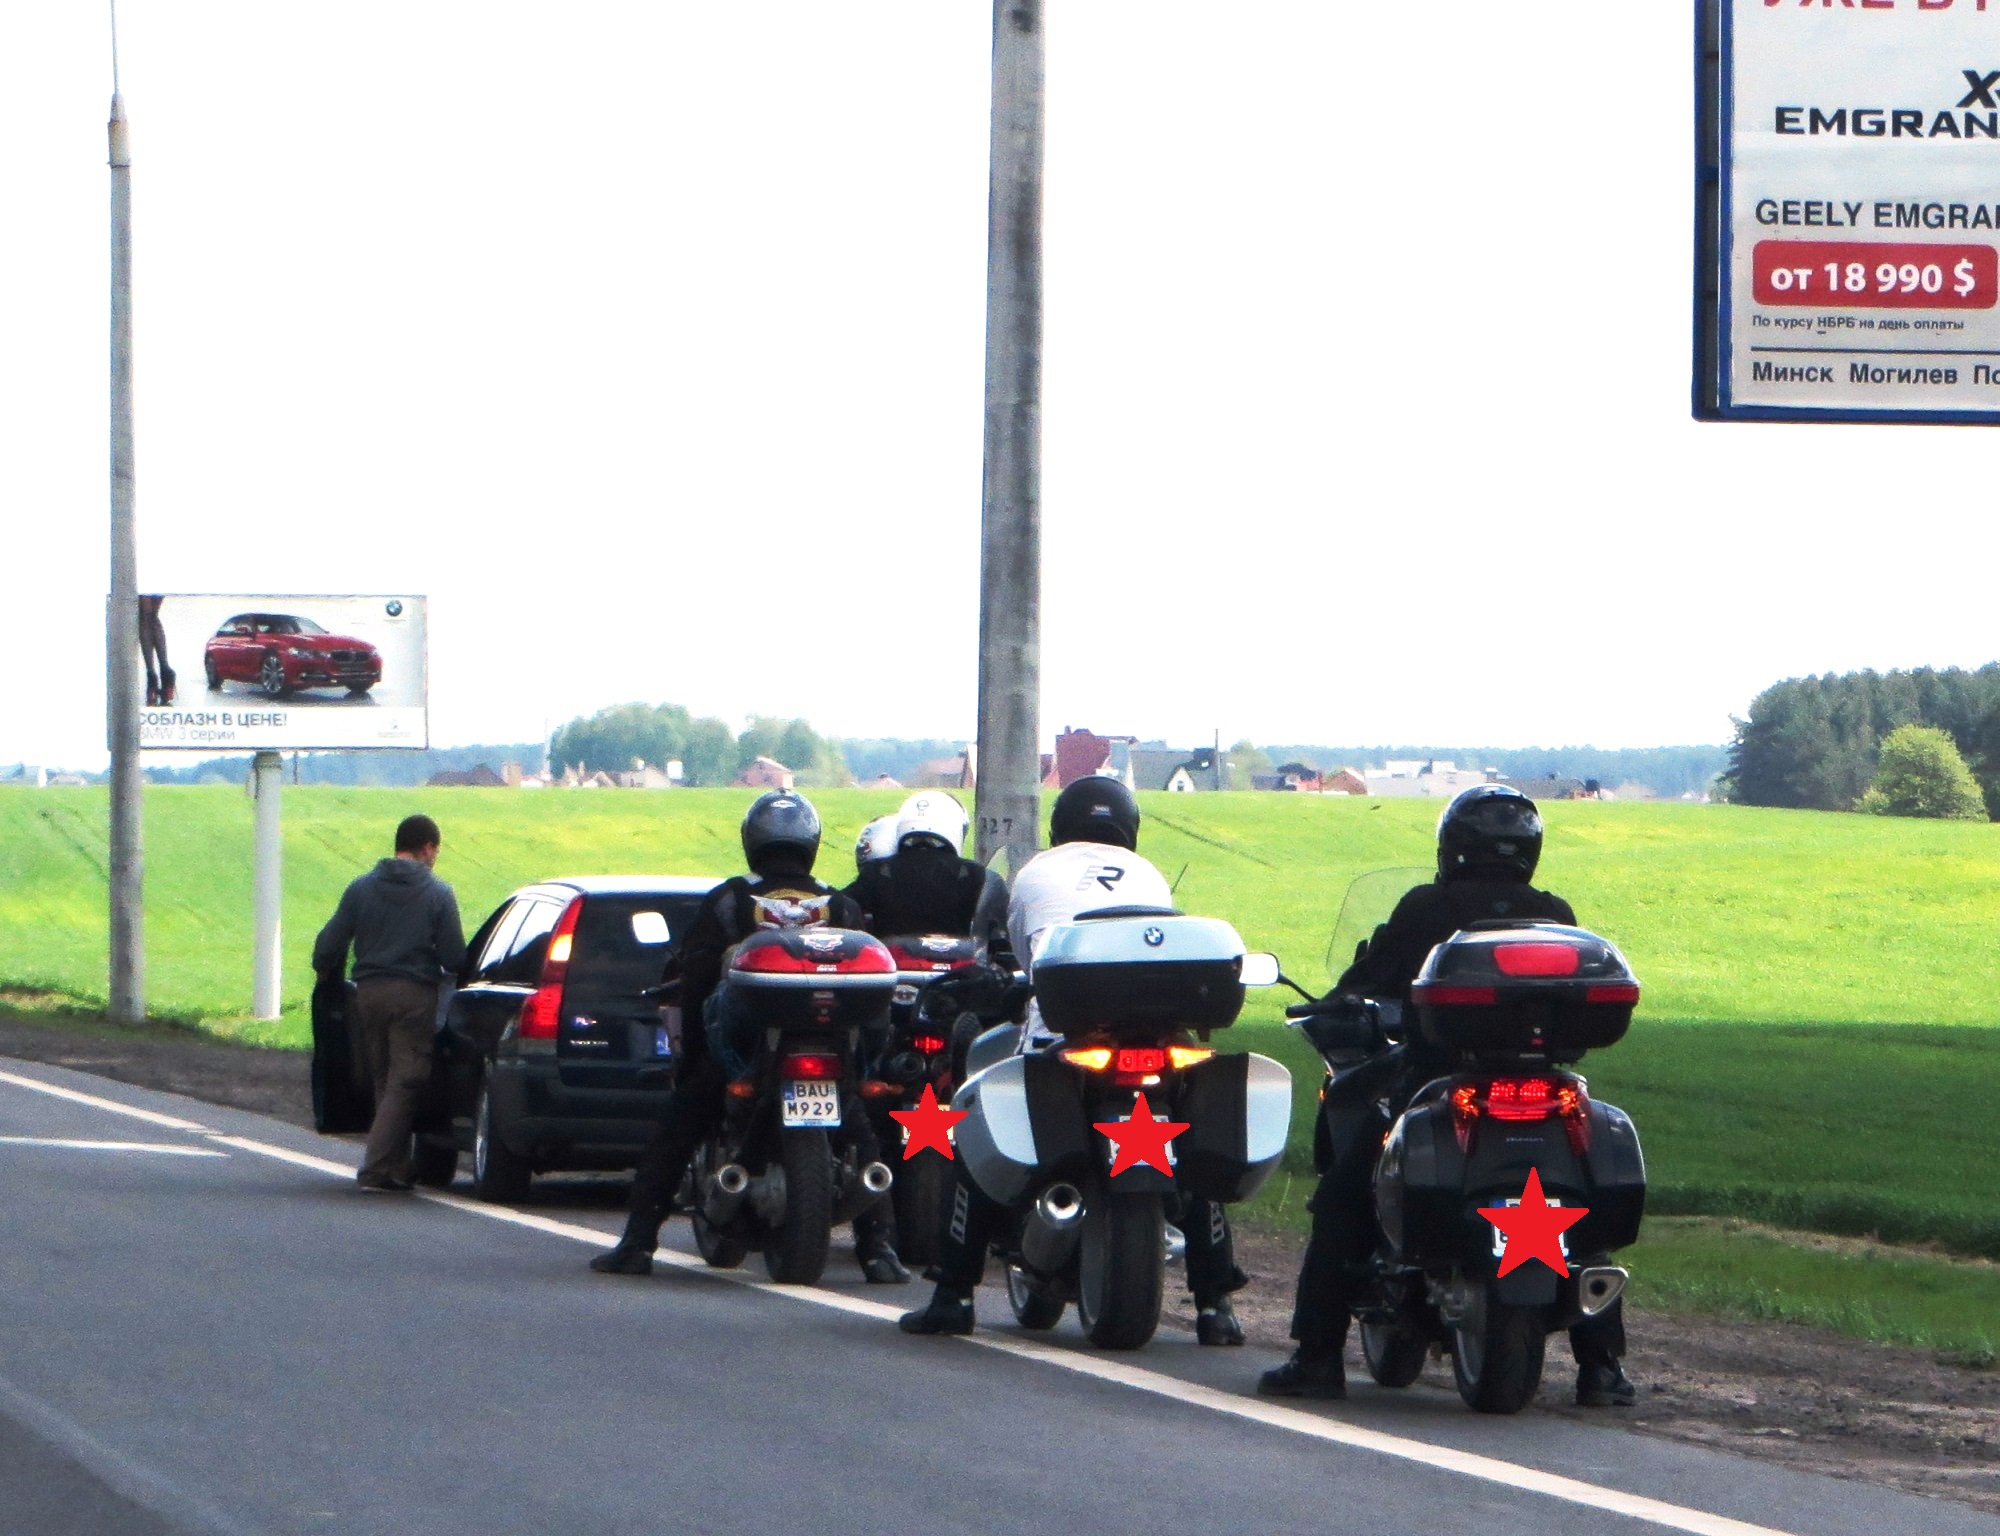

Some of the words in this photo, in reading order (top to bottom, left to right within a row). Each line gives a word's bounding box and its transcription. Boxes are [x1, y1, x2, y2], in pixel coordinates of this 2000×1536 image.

[1955, 70, 2000, 108] X
[1755, 199, 1863, 227] GEELY
[1770, 267, 1812, 291] от
[1824, 262, 1866, 292] 18
[1875, 263, 1943, 293] 990
[1953, 257, 1976, 297] $
[1752, 314, 1771, 327] По
[1774, 317, 1814, 330] курсу
[1859, 318, 1875, 329] на
[1878, 319, 1910, 331] день
[1914, 320, 1965, 331] оплаты
[1752, 361, 1834, 383] Минск
[1850, 363, 1958, 385] Могилев
[238, 713, 288, 729] ЦЕНЕ!
[190, 729, 235, 742] серии
[795, 1083, 829, 1097] BAU
[787, 1101, 834, 1116] M929
